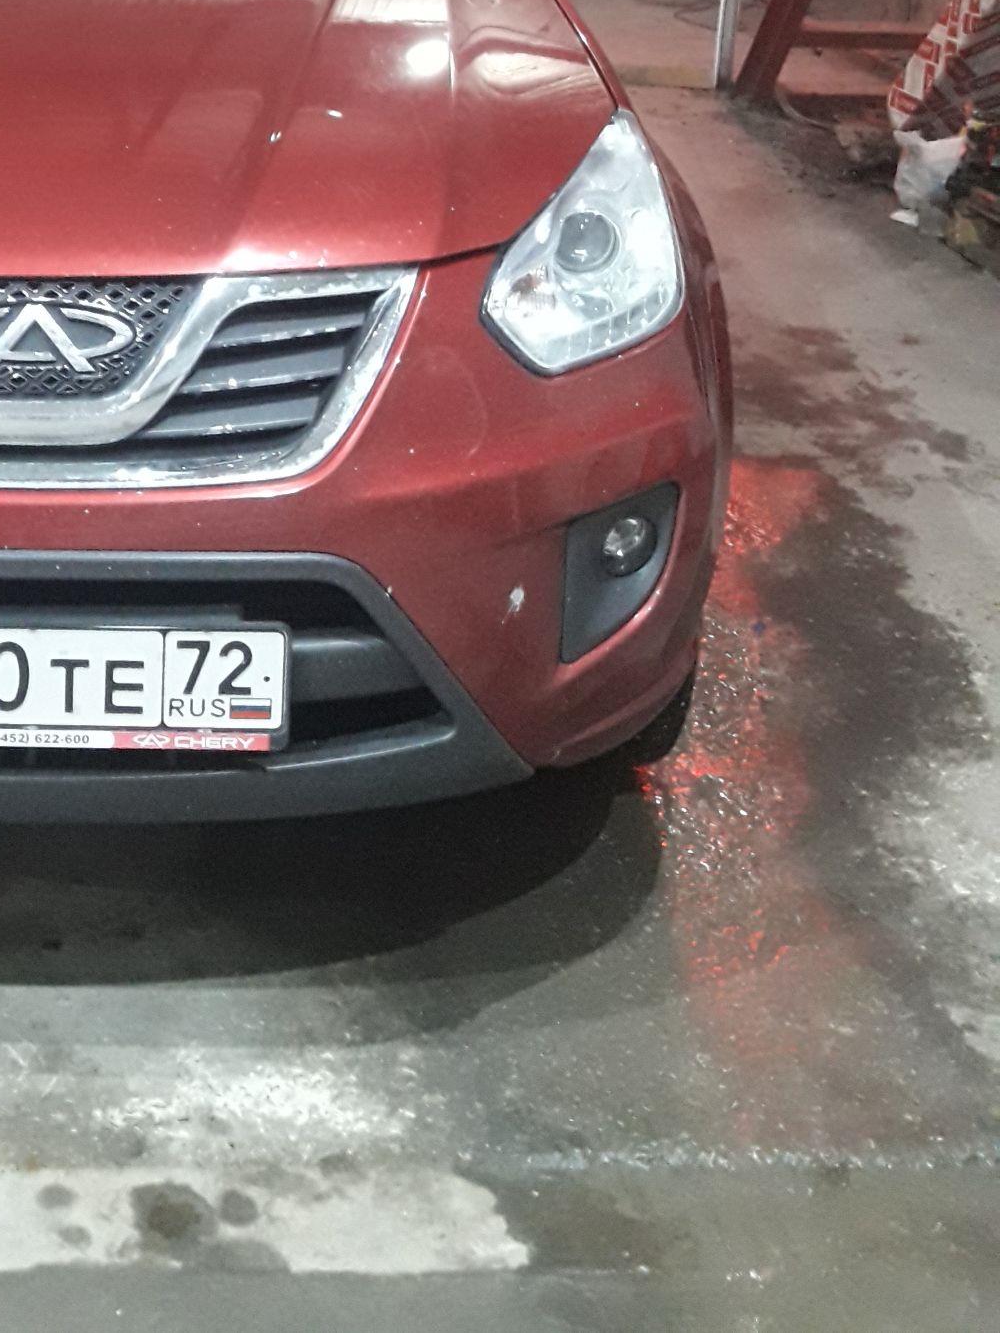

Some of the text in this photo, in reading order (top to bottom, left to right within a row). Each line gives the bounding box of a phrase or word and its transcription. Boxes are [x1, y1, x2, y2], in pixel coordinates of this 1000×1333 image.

[176, 640, 253, 695] 72
[169, 698, 226, 718] RUS
[173, 735, 256, 750] CHERY
